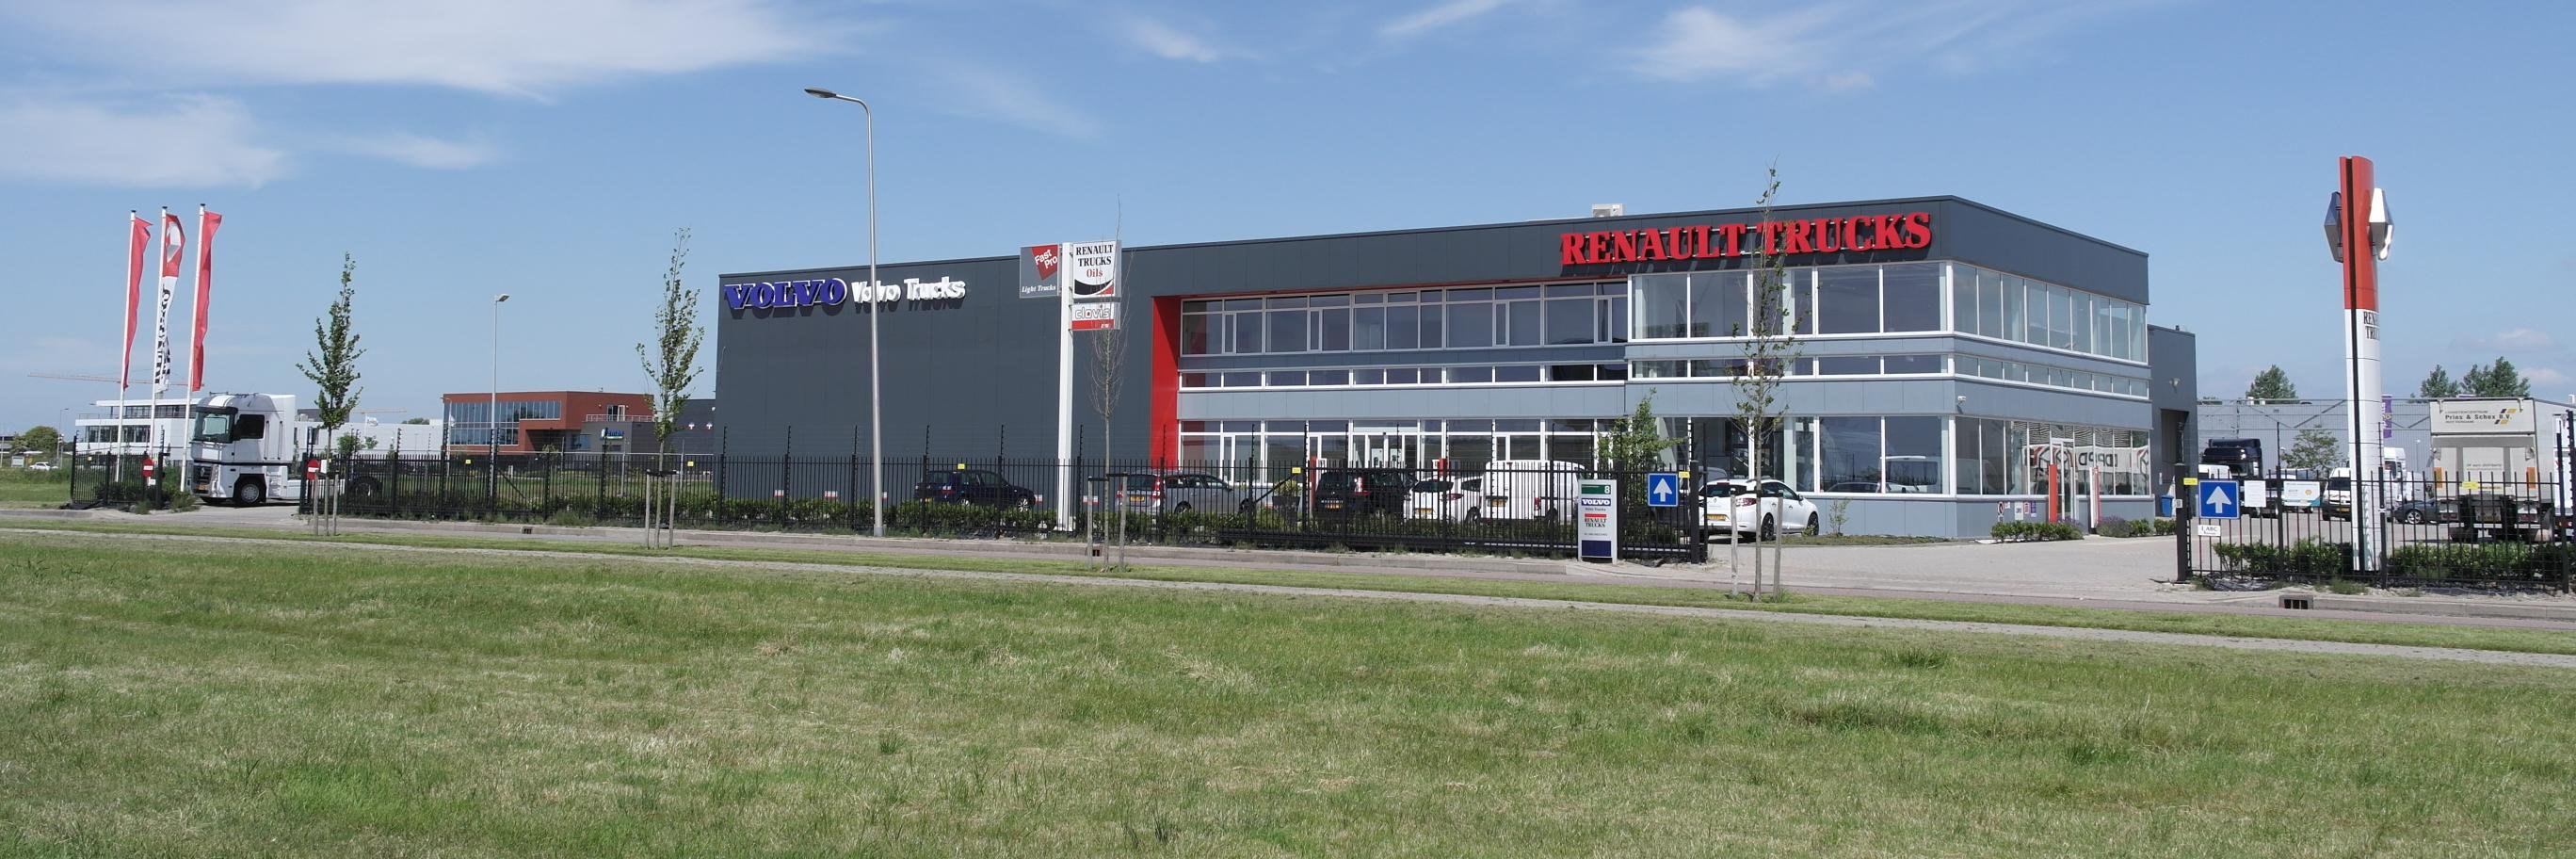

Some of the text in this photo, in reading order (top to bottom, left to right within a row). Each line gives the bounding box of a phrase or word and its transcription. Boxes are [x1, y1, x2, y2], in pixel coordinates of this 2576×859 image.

[1561, 213, 1931, 265] RENAULT TRUCKS
[1076, 245, 1113, 255] RENAULT
[1035, 249, 1053, 266] Fast
[1044, 256, 1058, 269] Pro
[1078, 256, 1112, 267] TRUCKS
[1087, 268, 1103, 278] Oils
[724, 276, 966, 309] VOLVO Volvo Trucks
[1022, 285, 1037, 294] Light
[1604, 485, 1610, 494] 8
